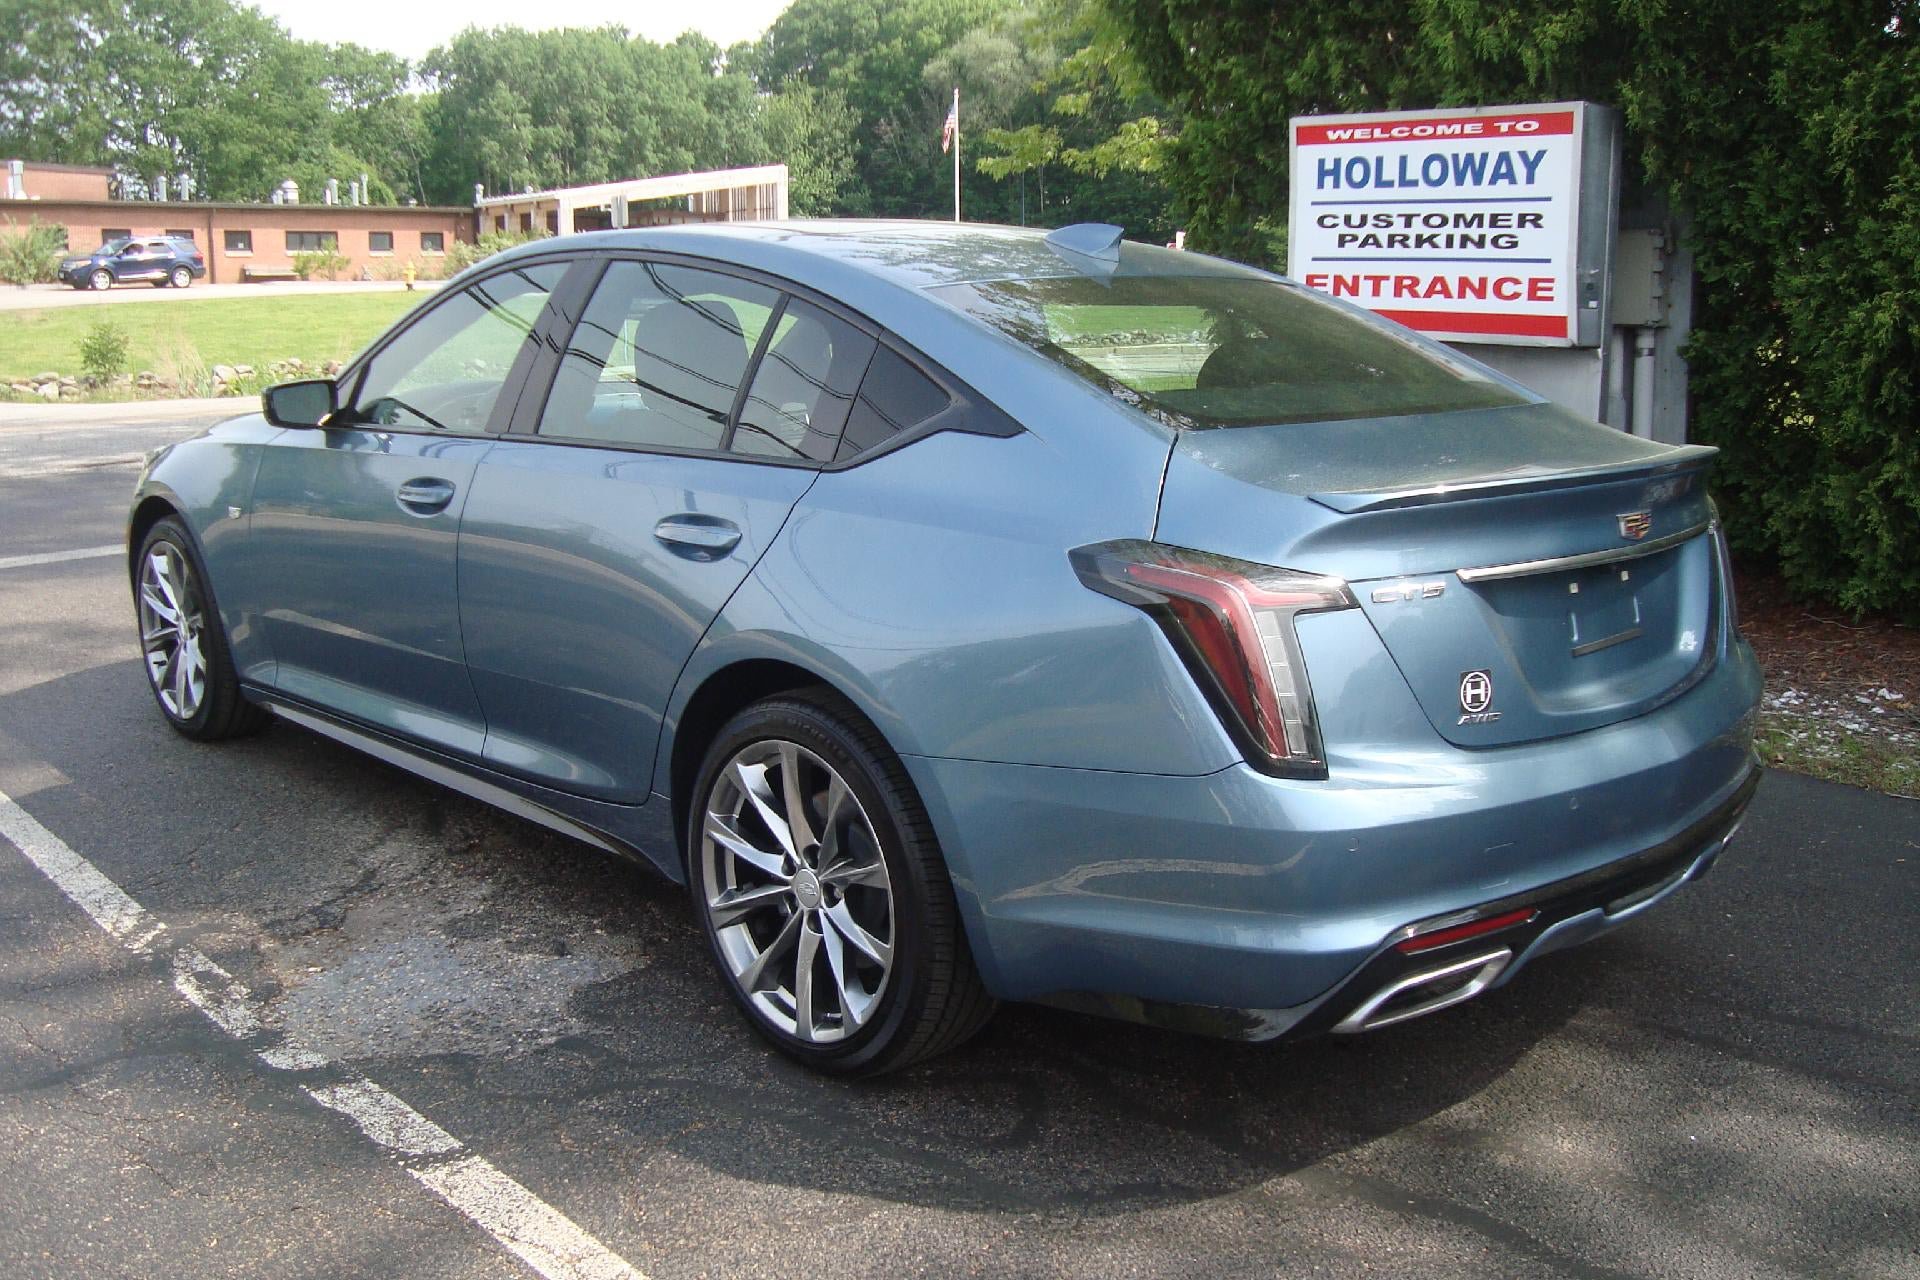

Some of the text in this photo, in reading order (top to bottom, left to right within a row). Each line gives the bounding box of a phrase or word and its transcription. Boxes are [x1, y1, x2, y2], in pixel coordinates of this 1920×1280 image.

[1326, 120, 1540, 141] WELCOME TO
[1316, 149, 1549, 190] HOLLOWAY
[1316, 212, 1545, 230] CUSTOMER
[1337, 233, 1520, 250] PARKING
[1305, 273, 1556, 302] ENTRANCE
